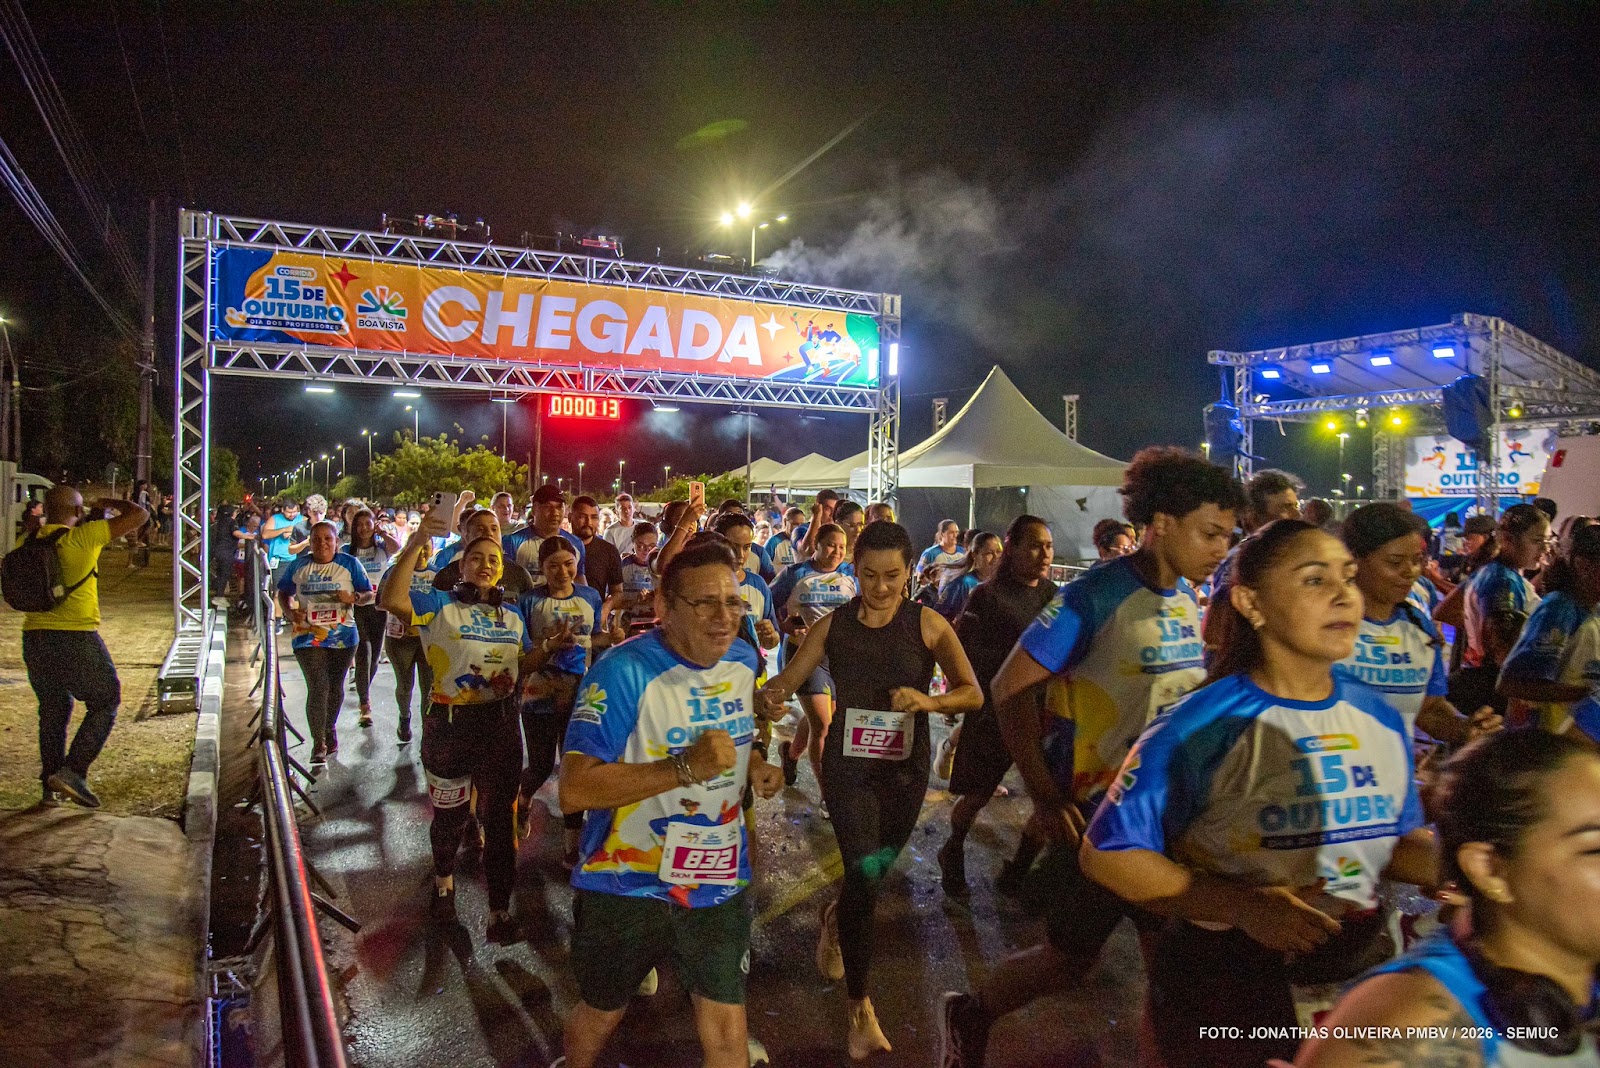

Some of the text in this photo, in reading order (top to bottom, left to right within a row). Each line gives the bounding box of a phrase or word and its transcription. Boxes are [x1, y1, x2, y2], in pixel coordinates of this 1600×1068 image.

[279, 268, 312, 278] CORRIDA
[267, 278, 324, 301] 15 DE
[245, 300, 344, 321] OUTUBRO
[285, 321, 339, 330] PROFESSORES
[358, 319, 405, 330] BOA VISTA
[422, 286, 763, 366] CHEGADA
[810, 579, 829, 592] 15
[471, 613, 494, 628] 15
[1156, 620, 1180, 642] 15
[1355, 642, 1412, 665] 15 DE
[687, 697, 744, 722] 15 DE
[860, 729, 898, 748] 627
[1290, 755, 1378, 795] 15 DE
[683, 849, 734, 869] 832
[670, 871, 691, 879] 5KM
